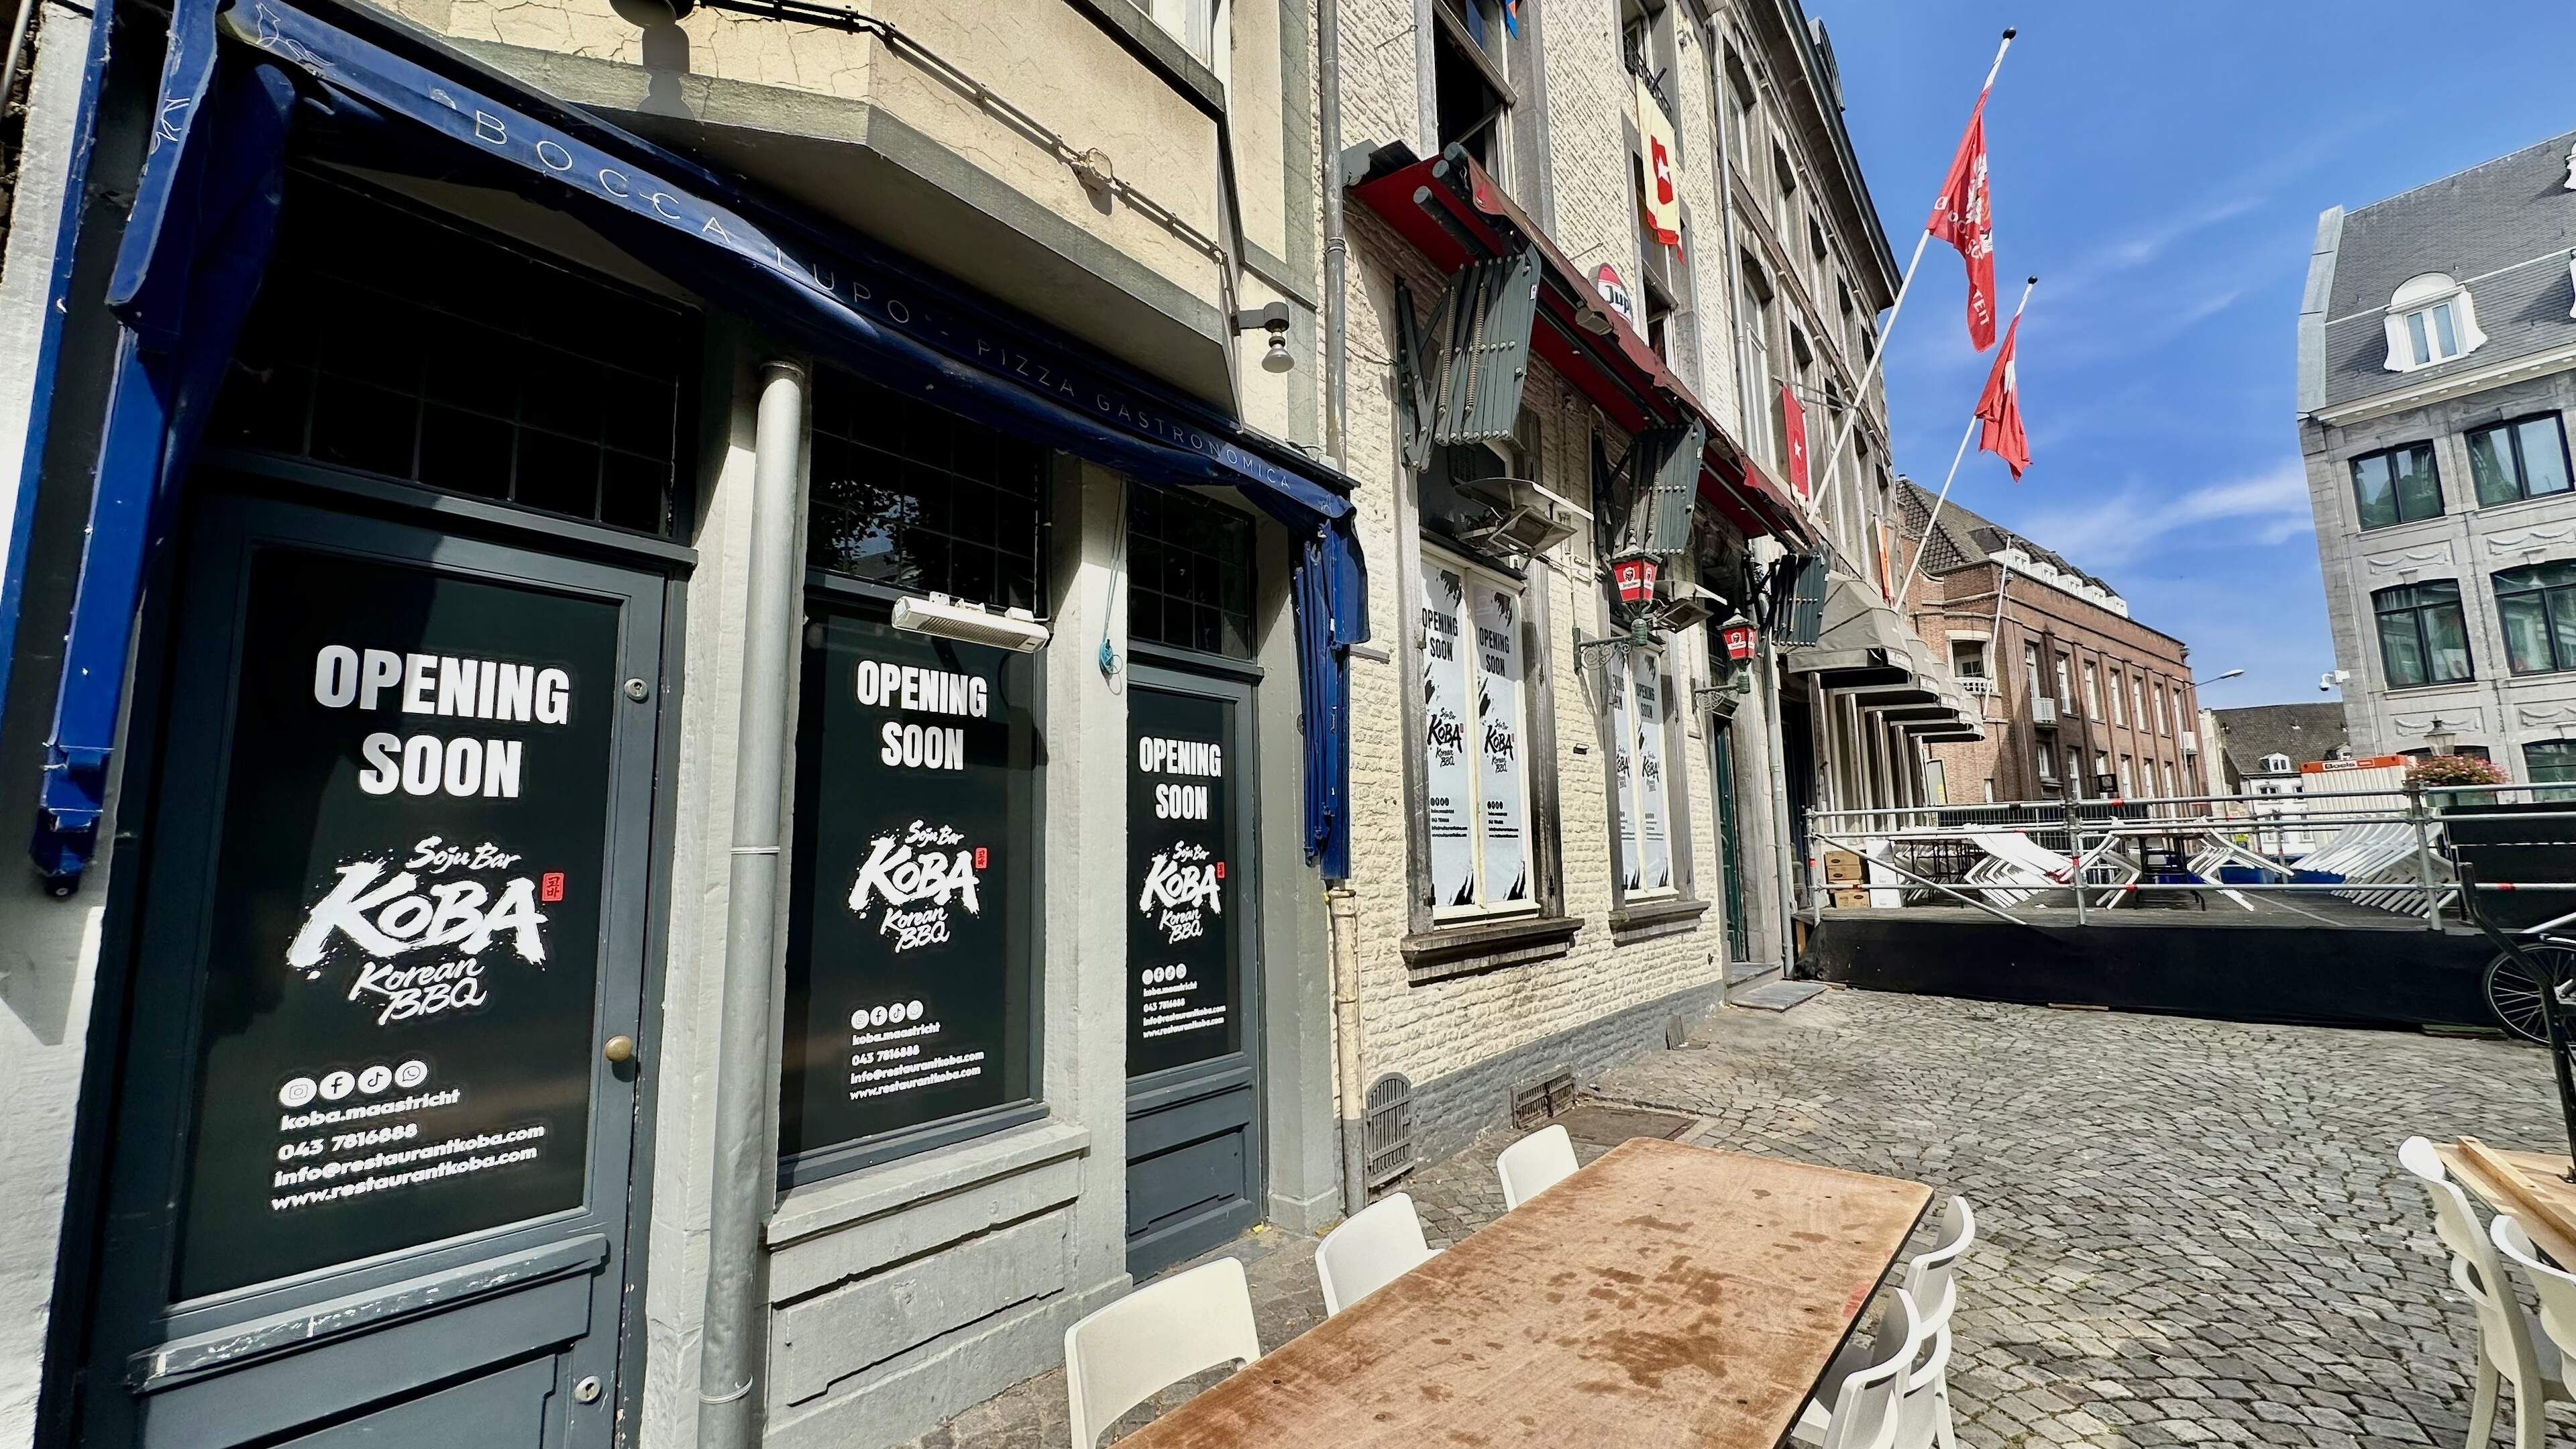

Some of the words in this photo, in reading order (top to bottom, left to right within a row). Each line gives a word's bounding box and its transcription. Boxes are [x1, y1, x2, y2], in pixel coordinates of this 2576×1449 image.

[475, 109, 731, 243] BOCCA
[776, 246, 910, 323] LUPO
[977, 339, 1075, 397] PIZZA
[1097, 393, 1291, 490] GASTRONOMICA
[1422, 607, 1458, 637] OPENING
[1479, 627, 1509, 653] OPENING
[1430, 637, 1453, 662] SOON
[1486, 653, 1505, 677] SOON
[314, 645, 572, 725] OPENING
[857, 660, 987, 718] OPENING
[358, 732, 523, 798] SOON
[881, 721, 963, 770] SOON
[1140, 737, 1222, 777] OPENING
[1155, 784, 1208, 820] SOON
[905, 819, 938, 848] Soju
[937, 824, 965, 845] Bar
[405, 835, 471, 874] Soju
[468, 842, 523, 870] Bar
[880, 907, 949, 935] Korean
[895, 920, 950, 953] BBQ
[1159, 908, 1201, 930] Korean
[1169, 920, 1203, 945] BBQ
[348, 957, 486, 1001] Korean
[378, 977, 488, 1026] BBQ
[852, 1022, 941, 1046] koba.maastricht
[852, 1051, 874, 1066] 043
[280, 1088, 461, 1131] koba.maastricht
[274, 1126, 545, 1188] info@restaurantkoba.com
[278, 1138, 325, 1161] 043
[331, 1122, 419, 1152] 7816888
[271, 1147, 538, 1210] www.restaurantkoba.com
